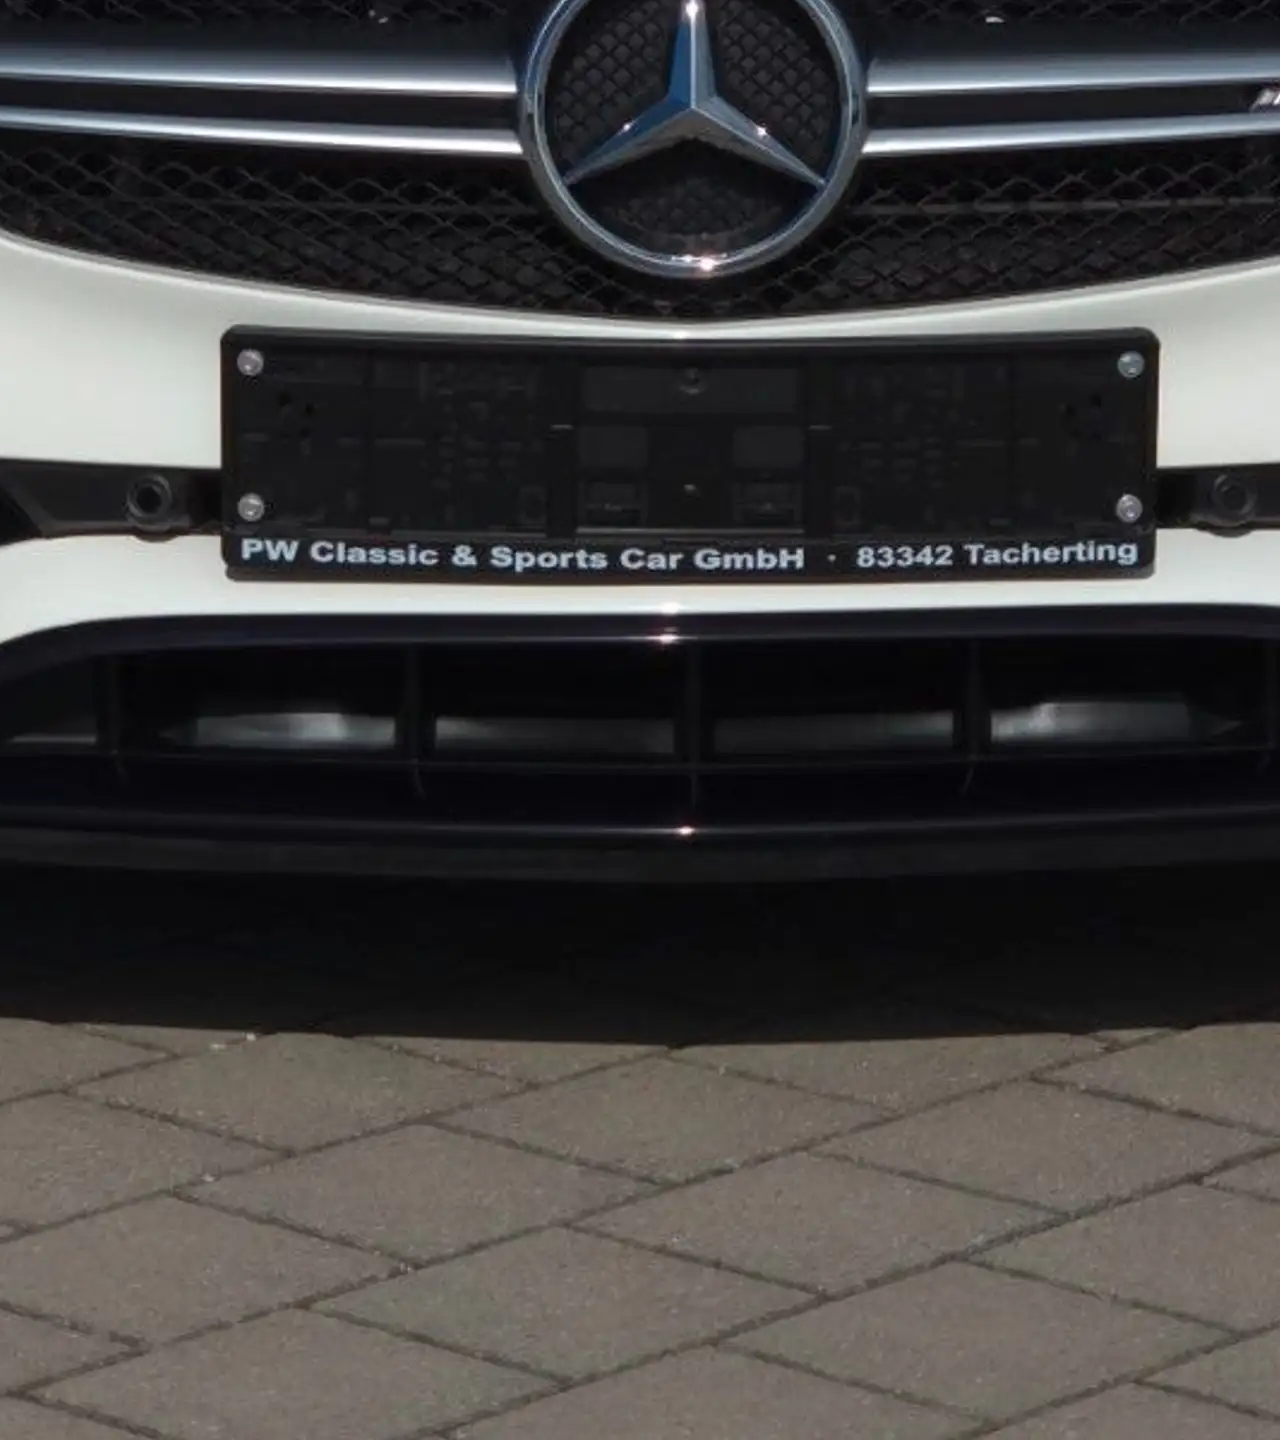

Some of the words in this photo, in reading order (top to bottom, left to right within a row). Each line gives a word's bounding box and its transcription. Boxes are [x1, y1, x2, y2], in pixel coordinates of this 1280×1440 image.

[240, 538, 300, 563] PW
[309, 540, 439, 567] Classic
[451, 544, 478, 568] &
[489, 545, 609, 573] Sports
[619, 547, 685, 571] Car
[693, 547, 806, 571] GmbH
[856, 544, 954, 569] 83342
[962, 540, 1140, 567] Tacherting
